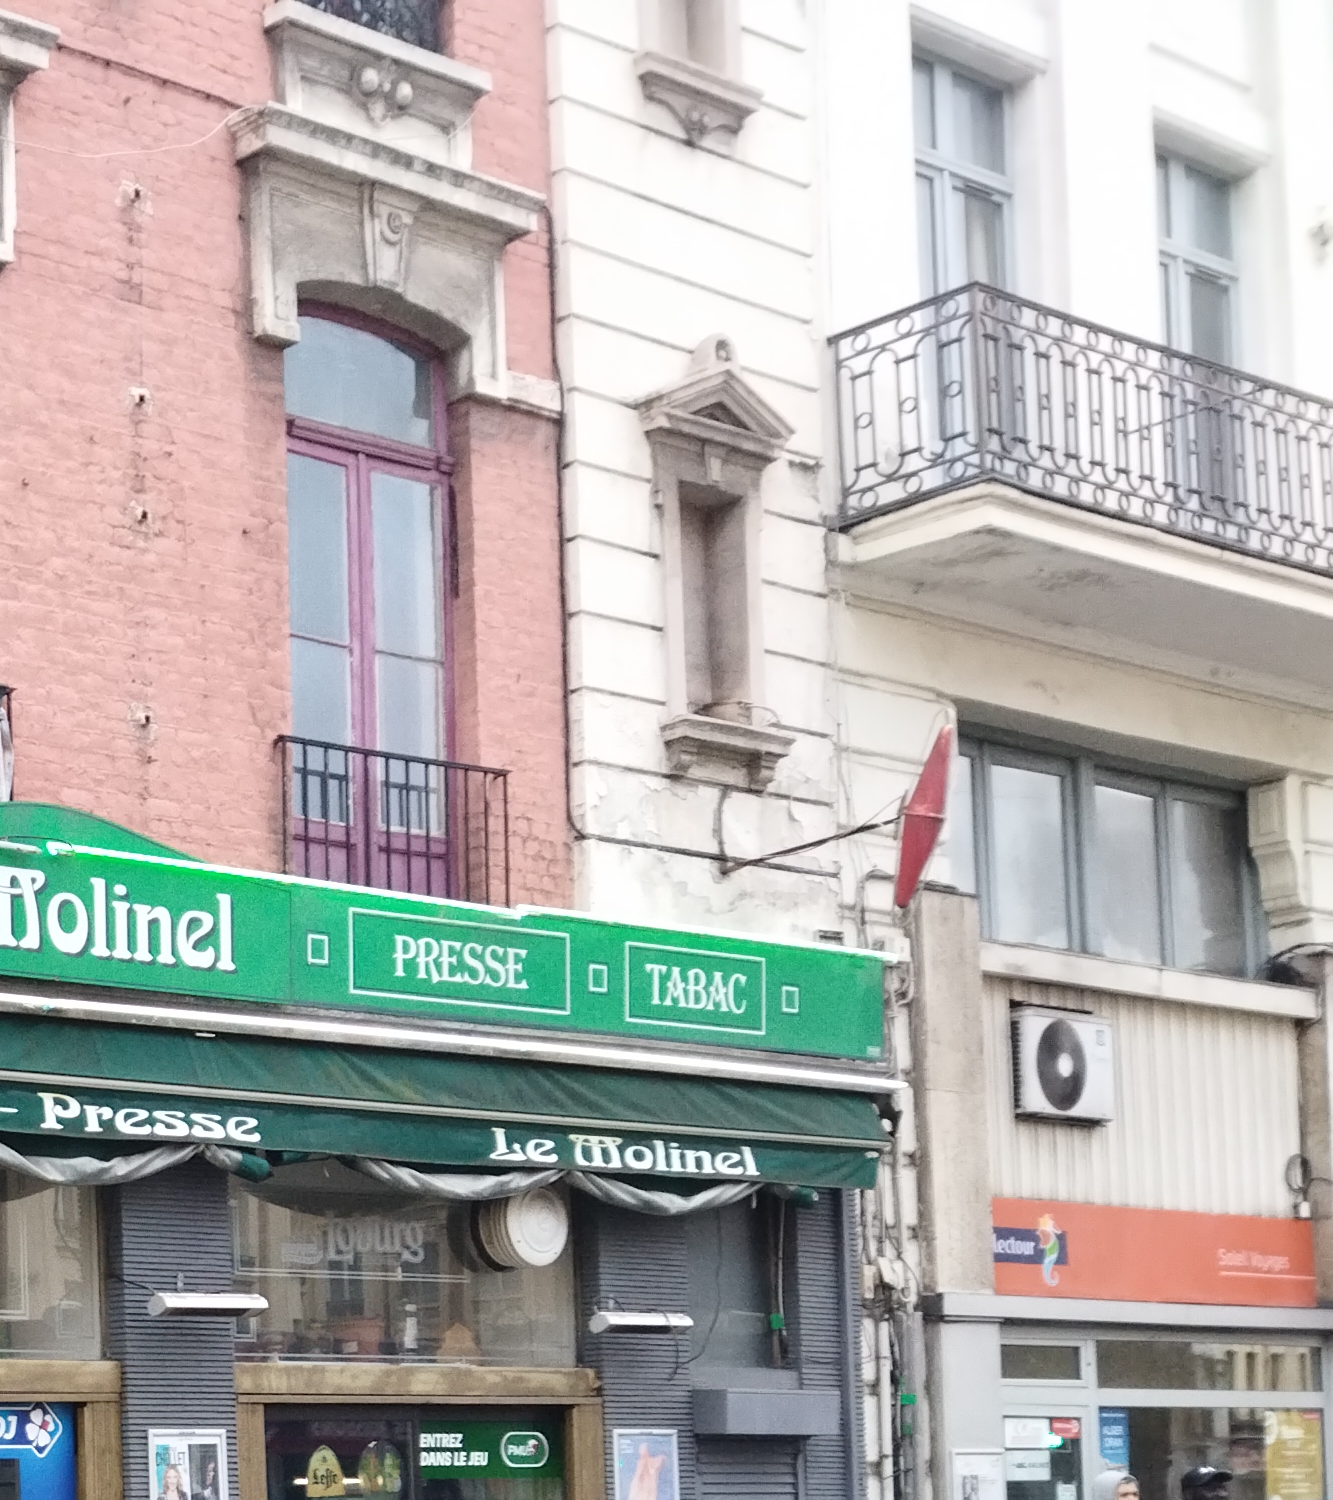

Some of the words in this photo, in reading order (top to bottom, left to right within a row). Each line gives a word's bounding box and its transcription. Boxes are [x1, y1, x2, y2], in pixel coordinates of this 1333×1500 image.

[392, 934, 530, 991] PRESSE
[644, 962, 747, 1015] TABAC
[38, 1092, 261, 1143] Presse
[490, 1127, 559, 1164] Le
[567, 1133, 760, 1177] Molinel
[419, 1433, 463, 1448] ENTREZ
[420, 1452, 452, 1467] DANS
[453, 1452, 467, 1466] LE
[468, 1452, 489, 1466] JEU
[312, 1468, 338, 1491] Leffe
